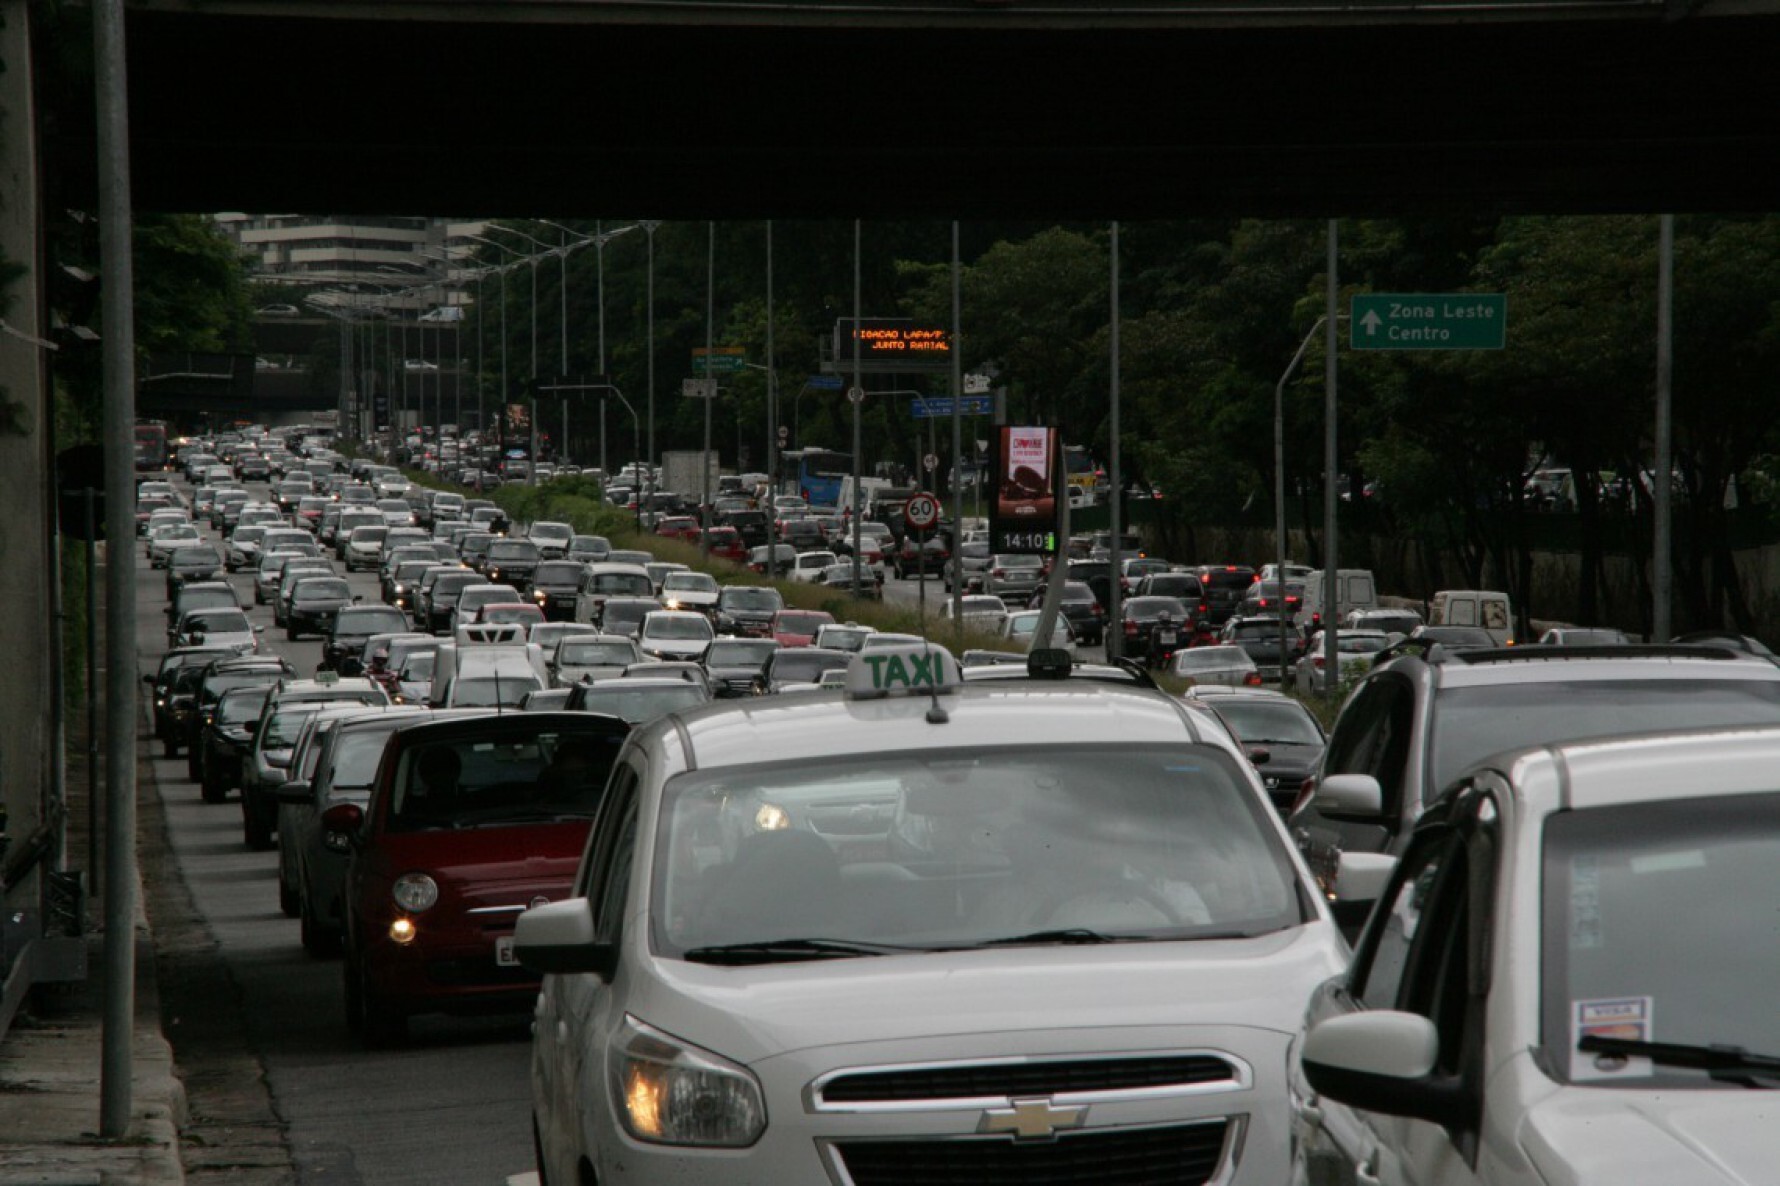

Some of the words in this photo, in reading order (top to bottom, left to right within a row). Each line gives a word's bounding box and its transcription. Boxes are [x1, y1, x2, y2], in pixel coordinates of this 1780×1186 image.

[1389, 303, 1436, 318] Zona
[1443, 302, 1495, 318] Leste
[1388, 325, 1450, 340] Centro
[910, 501, 931, 515] 60
[1004, 533, 1043, 549] 14:10
[862, 651, 944, 689] TAXI
